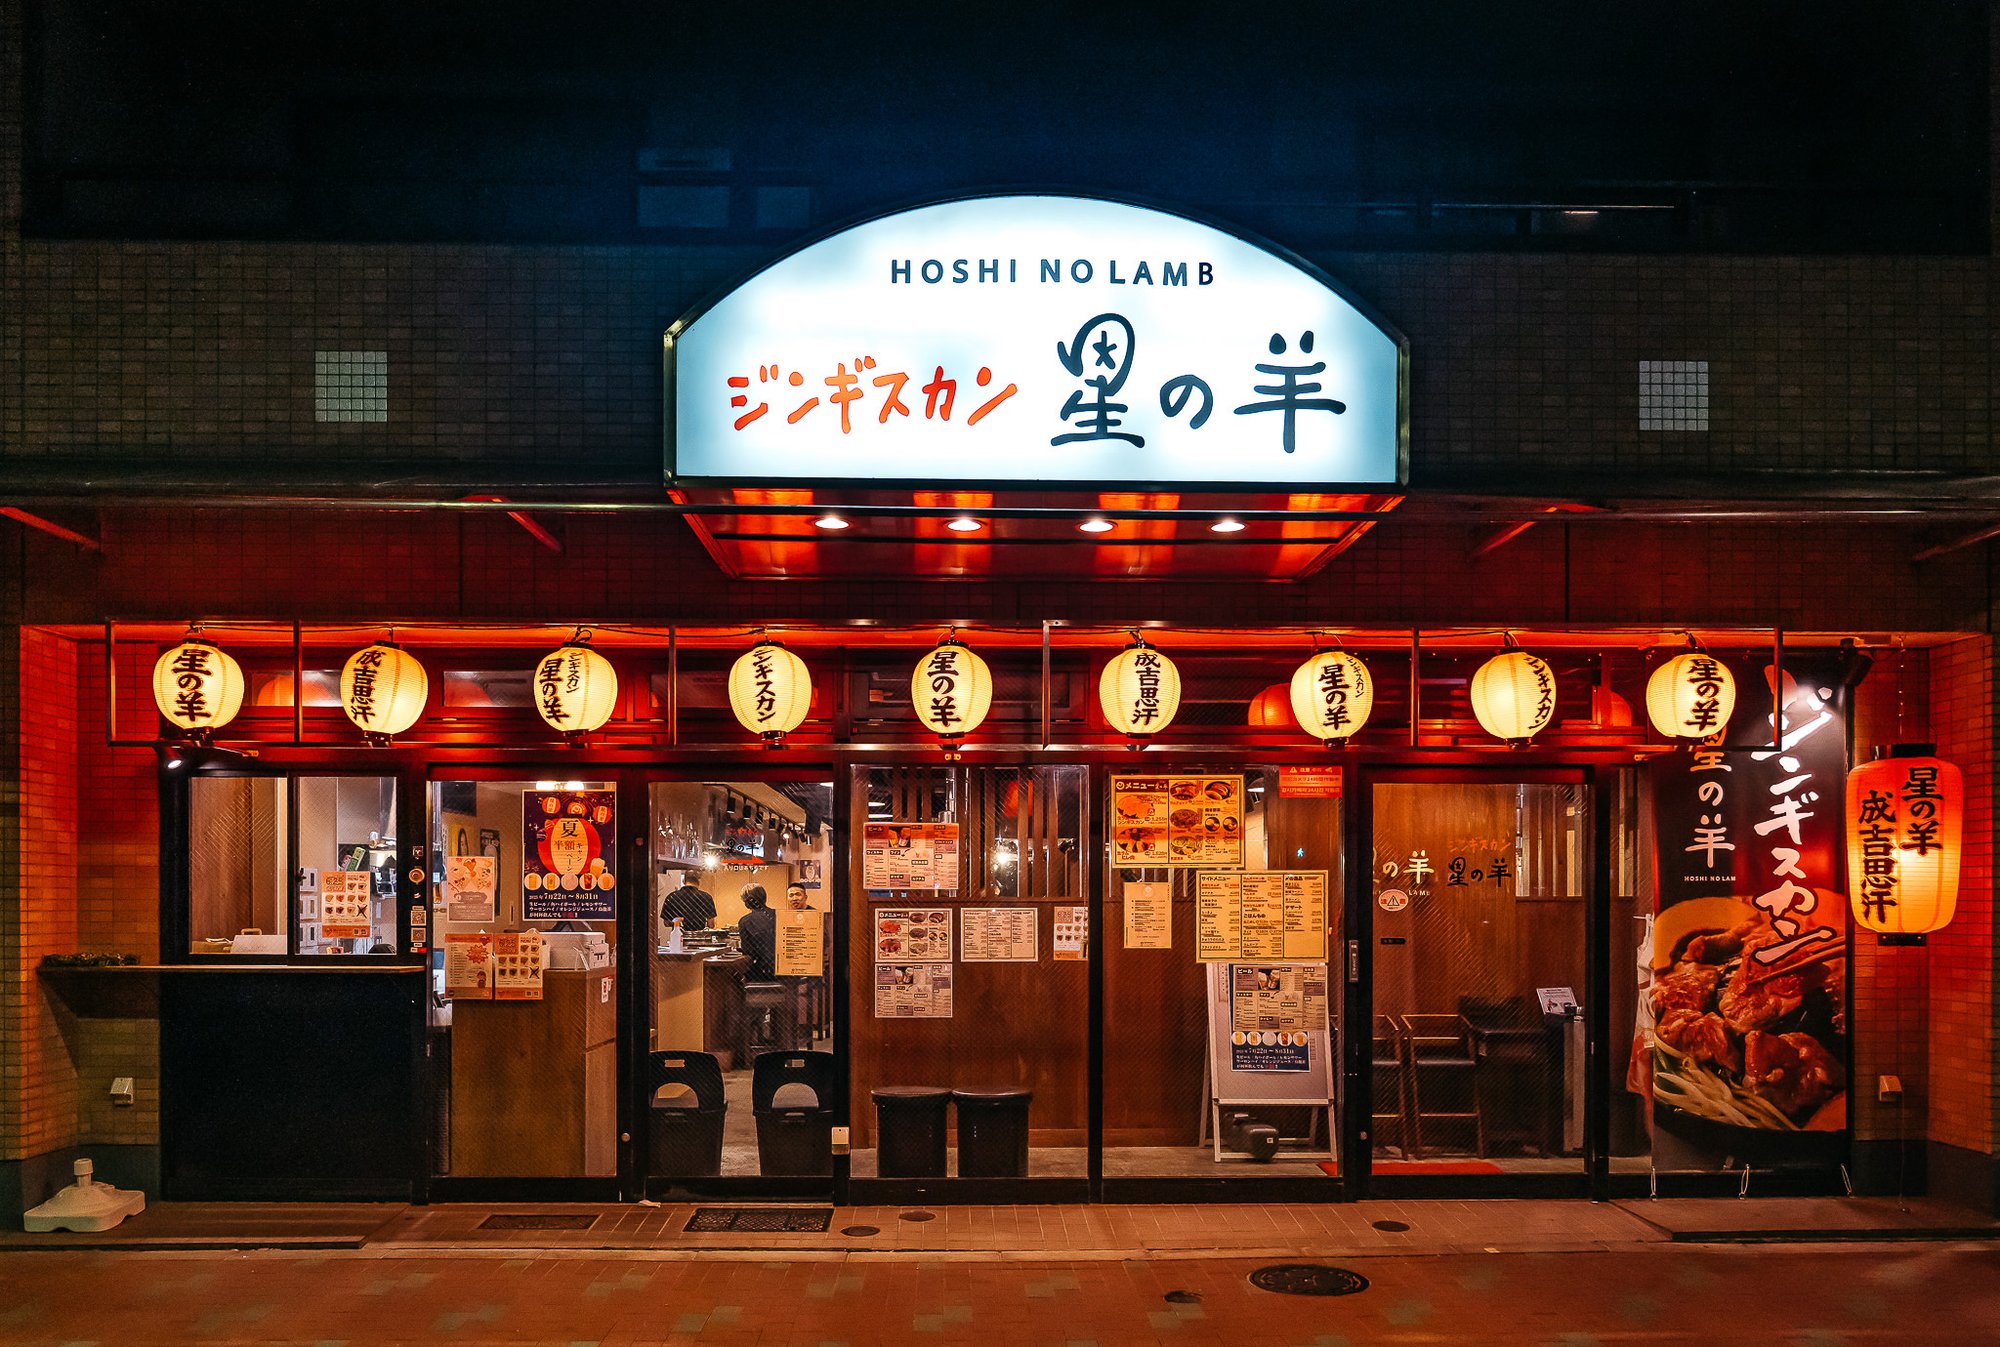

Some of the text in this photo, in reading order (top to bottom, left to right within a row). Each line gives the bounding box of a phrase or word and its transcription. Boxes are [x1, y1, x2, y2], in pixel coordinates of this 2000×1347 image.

[892, 258, 1215, 287] HOSHI NO LAMB
[727, 312, 1346, 453] ジンギスカン 星の羊
[171, 649, 214, 722] 星の羊
[350, 650, 387, 724] 成吉思汗
[539, 658, 571, 724] 星の羊
[927, 651, 963, 728] 星の羊
[1131, 652, 1162, 726] 成吉思汗
[1318, 663, 1353, 731] 星の羊
[1683, 658, 1724, 732] 星の羊
[560, 819, 579, 838] 夏
[1750, 664, 1837, 967] ジンギスカン
[1899, 766, 1945, 857] 星の羊
[1447, 856, 1512, 887] 星の羊
[1858, 789, 1898, 924] 成吉思汗
